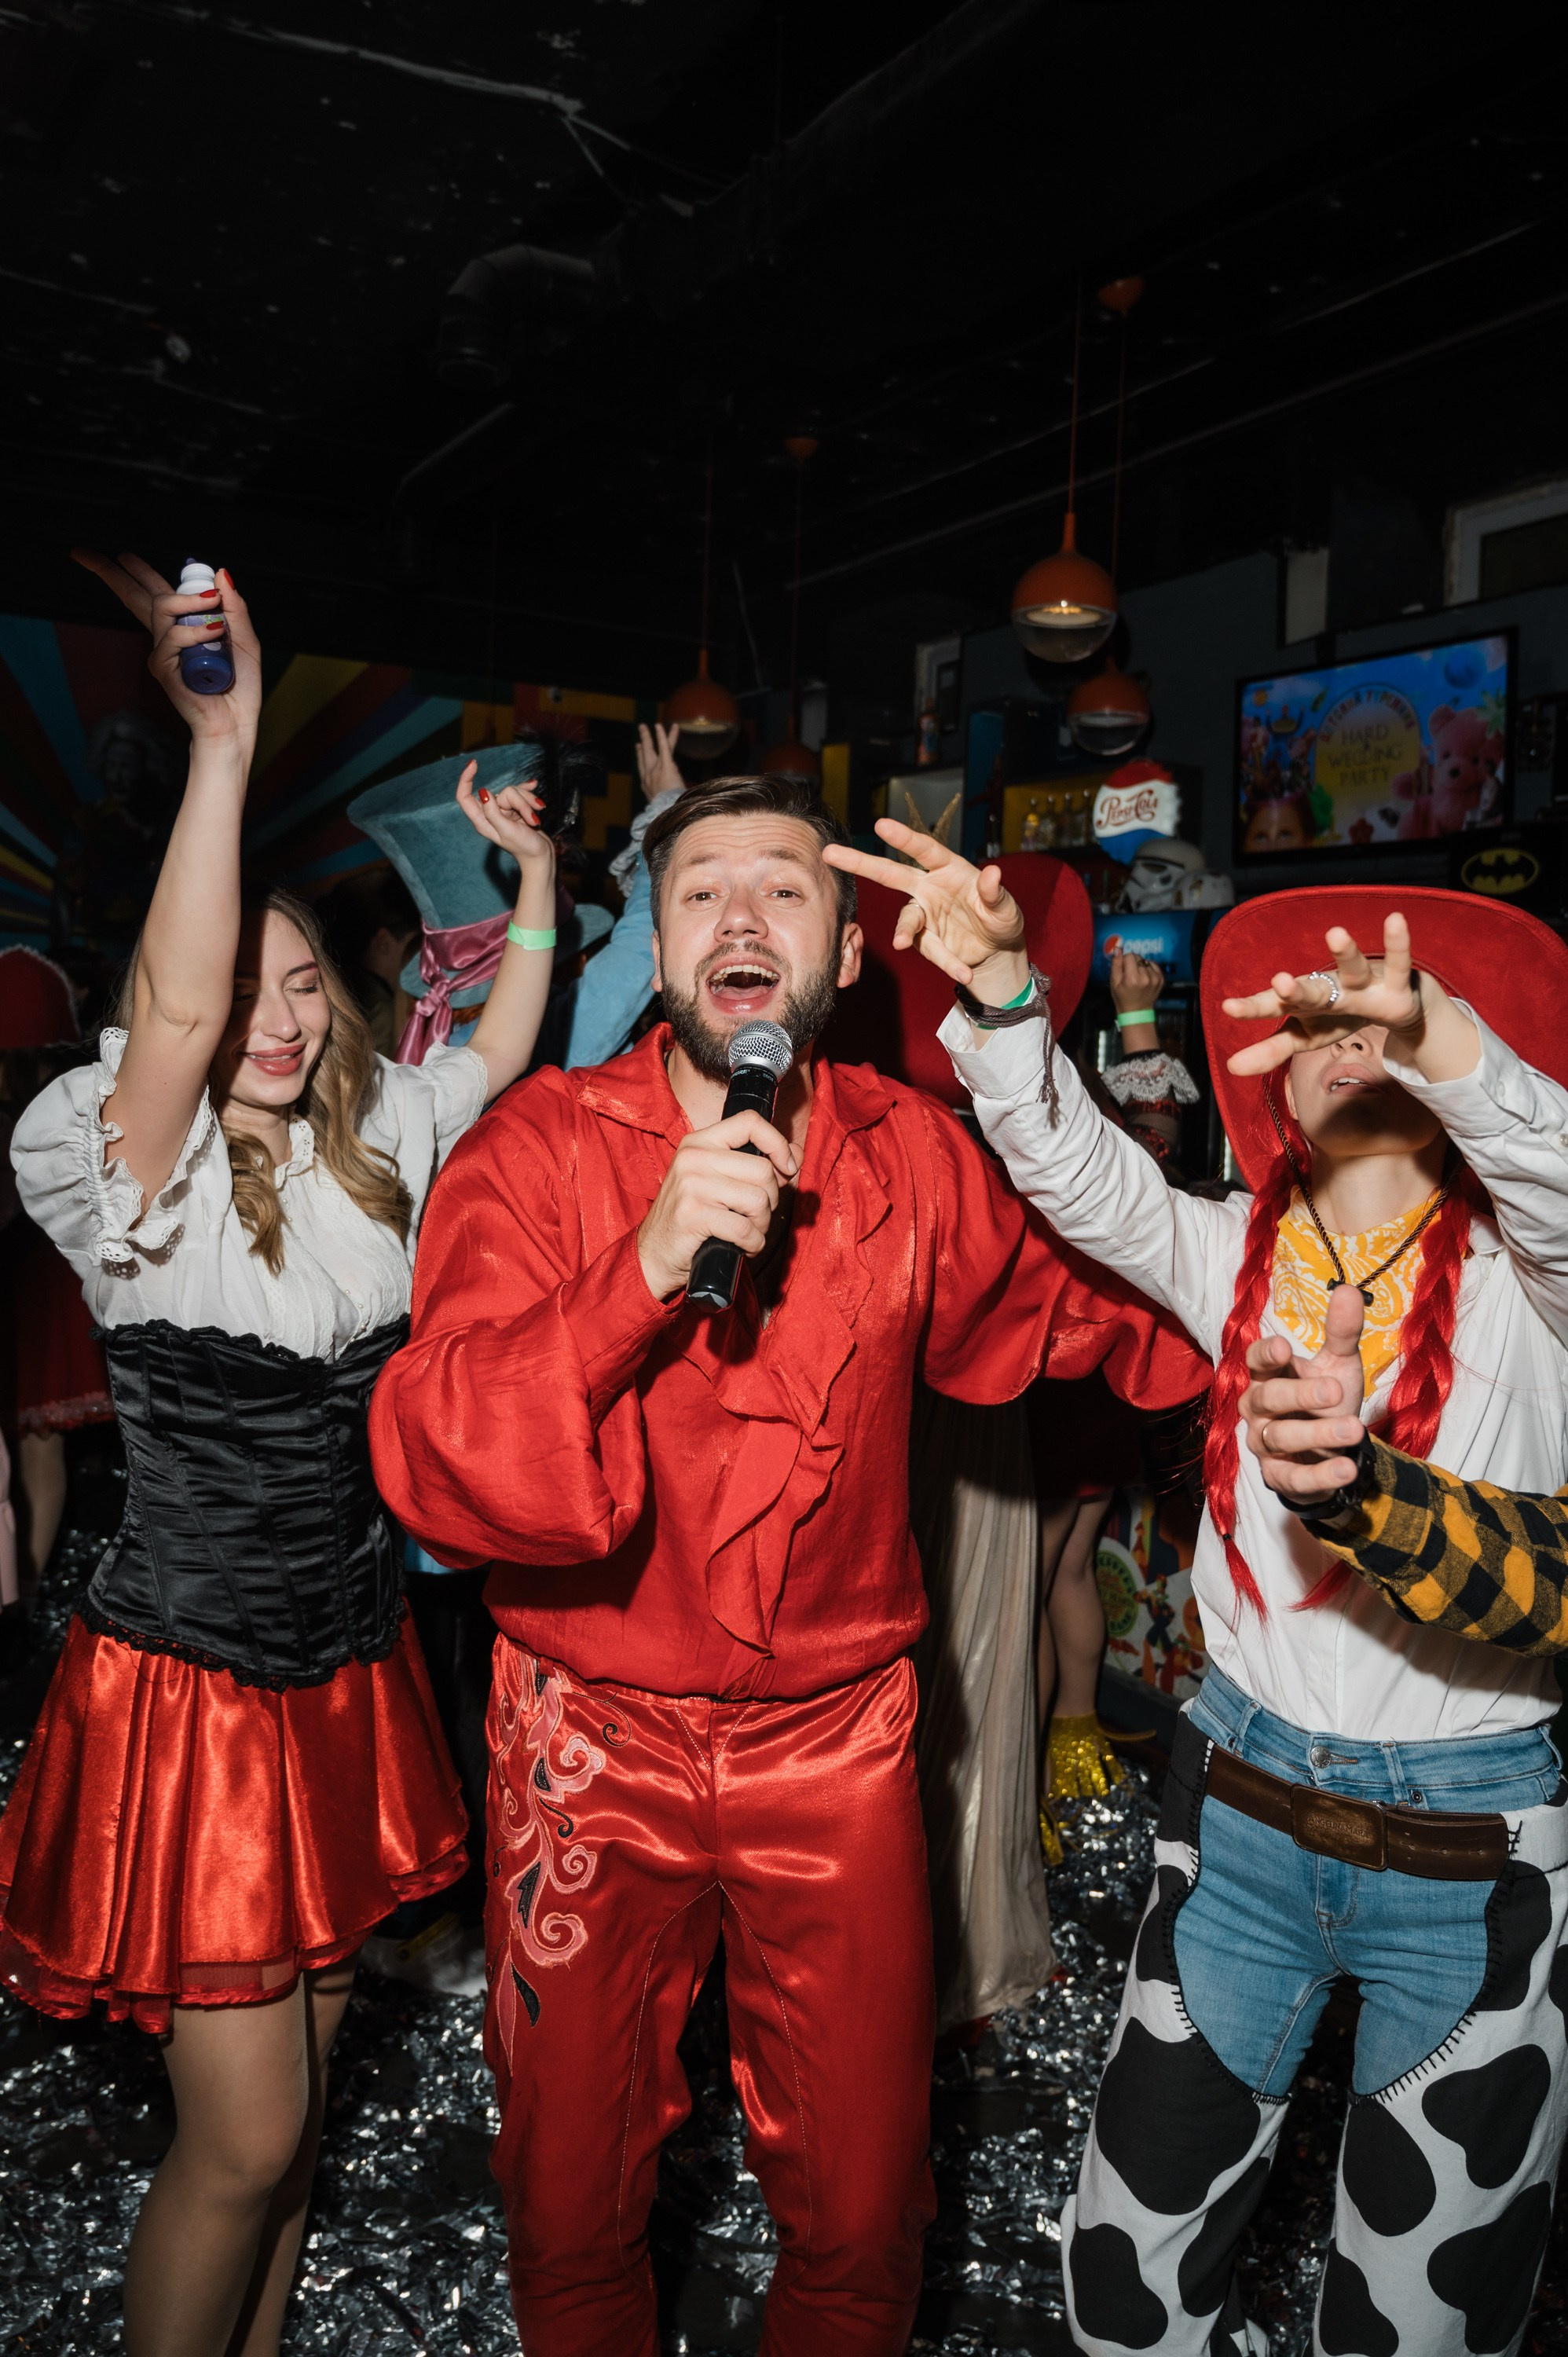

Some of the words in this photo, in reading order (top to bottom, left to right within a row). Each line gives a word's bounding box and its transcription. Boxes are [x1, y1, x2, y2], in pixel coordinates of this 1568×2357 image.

[1341, 724, 1390, 746] HARD
[1339, 767, 1390, 786] PARTY
[1123, 936, 1164, 959] pepsi
